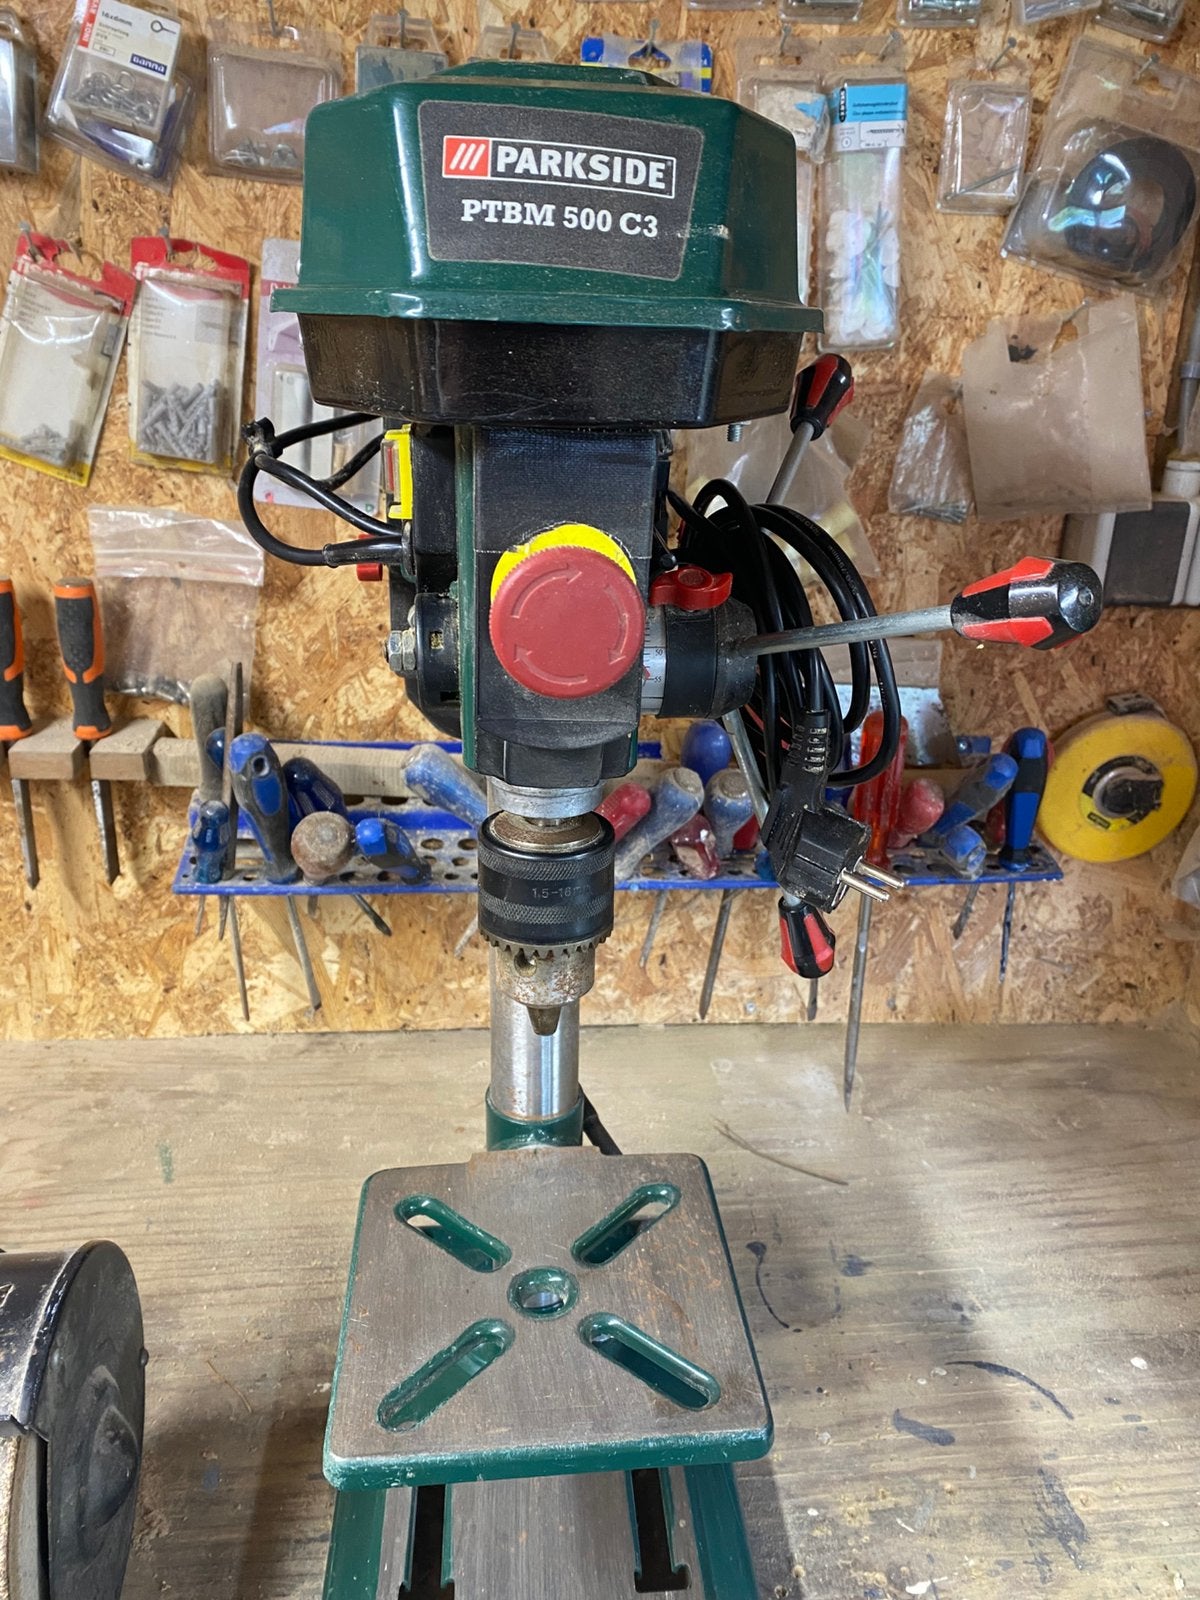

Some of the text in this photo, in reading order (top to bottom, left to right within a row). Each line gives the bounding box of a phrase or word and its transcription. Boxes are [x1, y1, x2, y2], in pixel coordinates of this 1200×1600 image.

[496, 145, 666, 190] PARKSIDE
[460, 199, 658, 238] PTBM 500 C3
